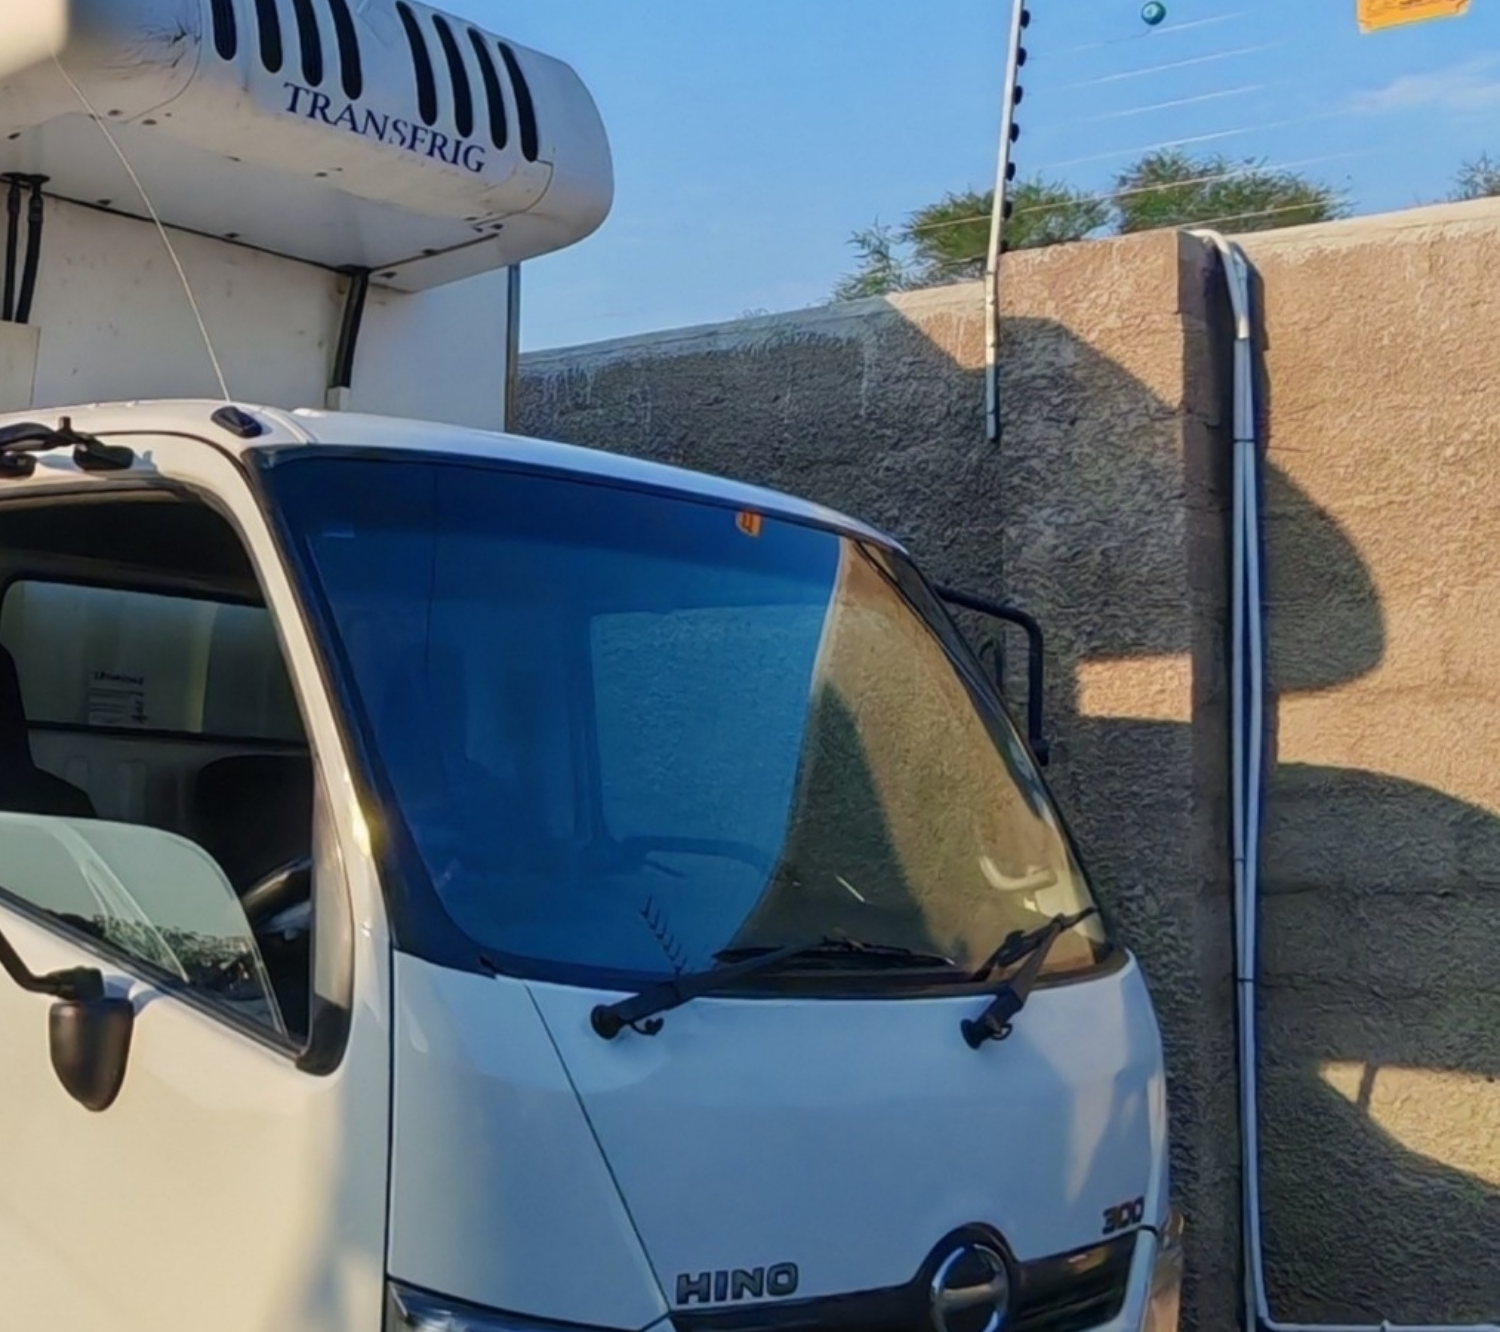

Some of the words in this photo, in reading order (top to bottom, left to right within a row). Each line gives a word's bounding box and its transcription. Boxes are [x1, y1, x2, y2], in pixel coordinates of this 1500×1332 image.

[283, 82, 486, 173] TRANSFRIG
[1102, 1196, 1145, 1235] 300
[676, 1261, 798, 1305] HINO
